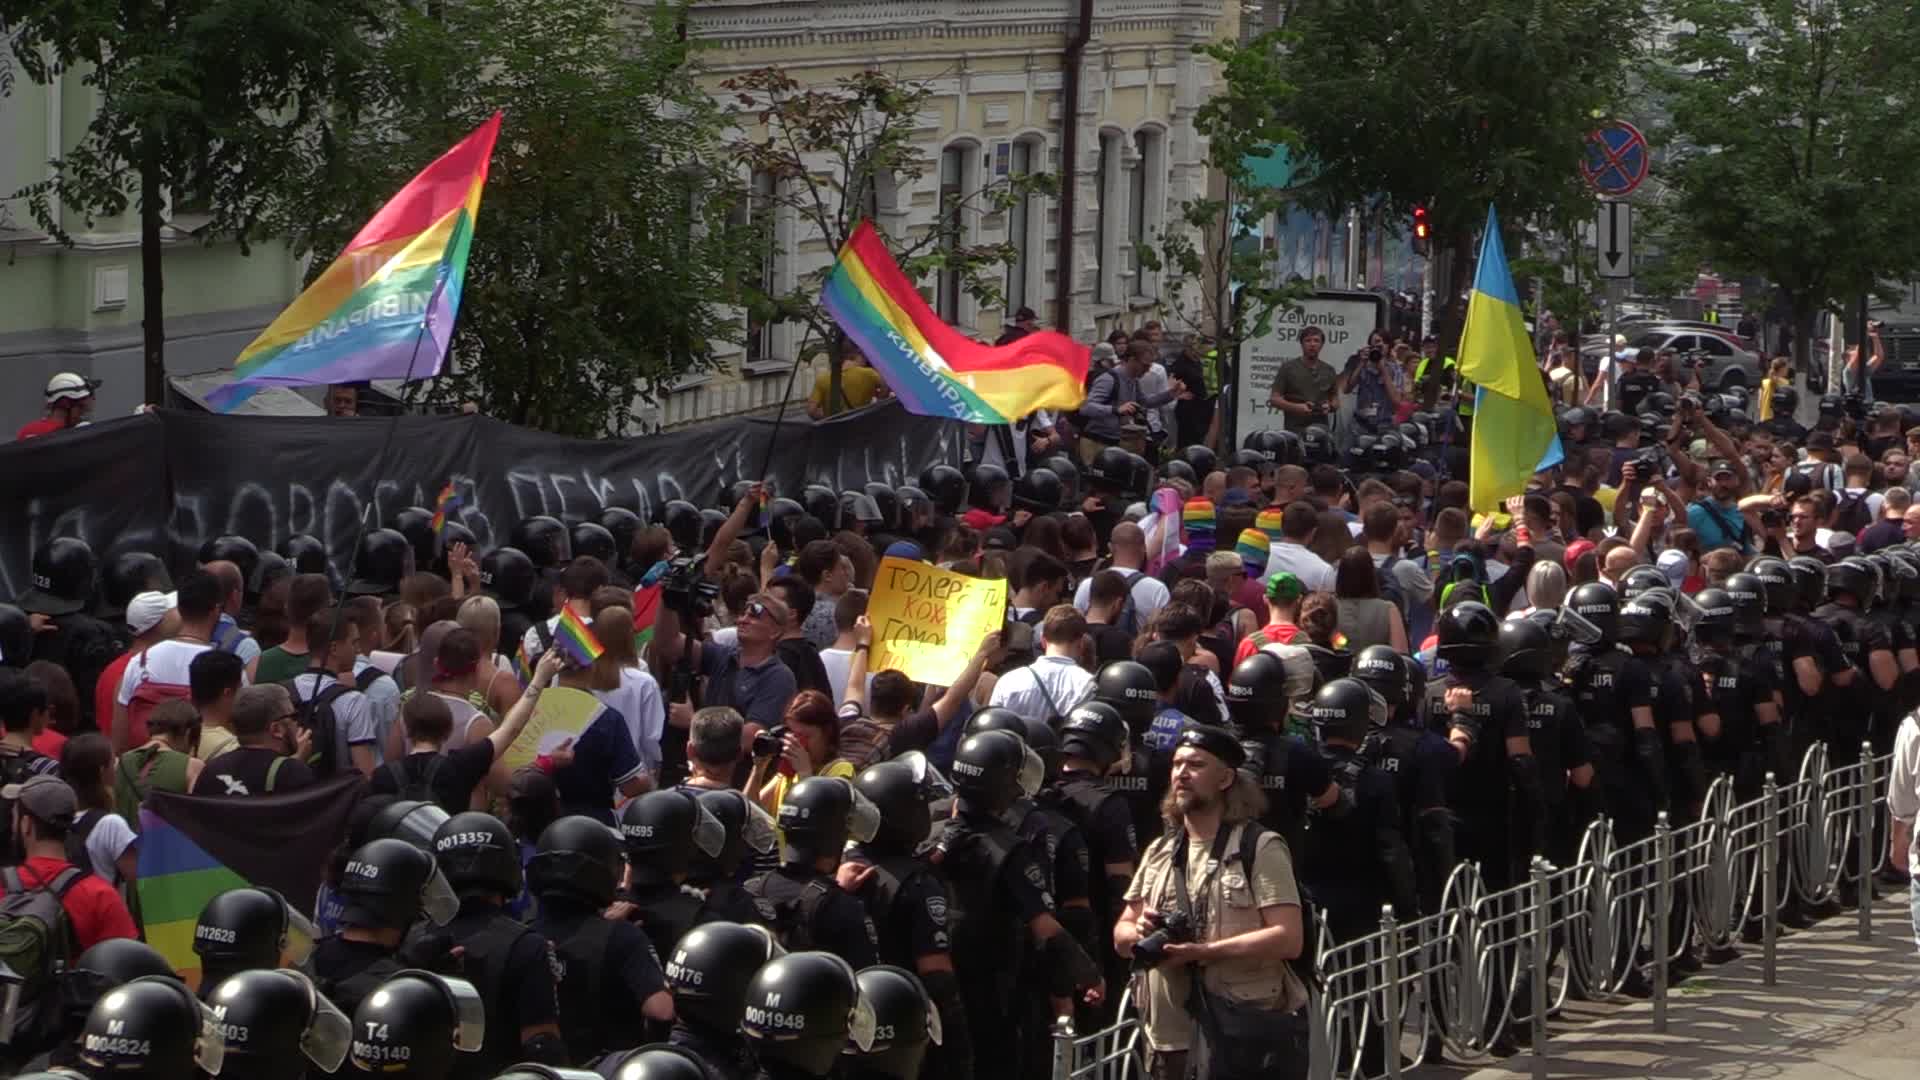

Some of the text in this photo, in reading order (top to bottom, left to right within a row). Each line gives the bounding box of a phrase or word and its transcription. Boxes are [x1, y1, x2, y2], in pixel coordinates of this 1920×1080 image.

[1278, 308, 1345, 327] Zelyonka
[1328, 331, 1349, 344] UP
[436, 831, 493, 852] 0013357
[765, 991, 781, 1008] M
[106, 1019, 125, 1036] M
[365, 1021, 390, 1041] T4
